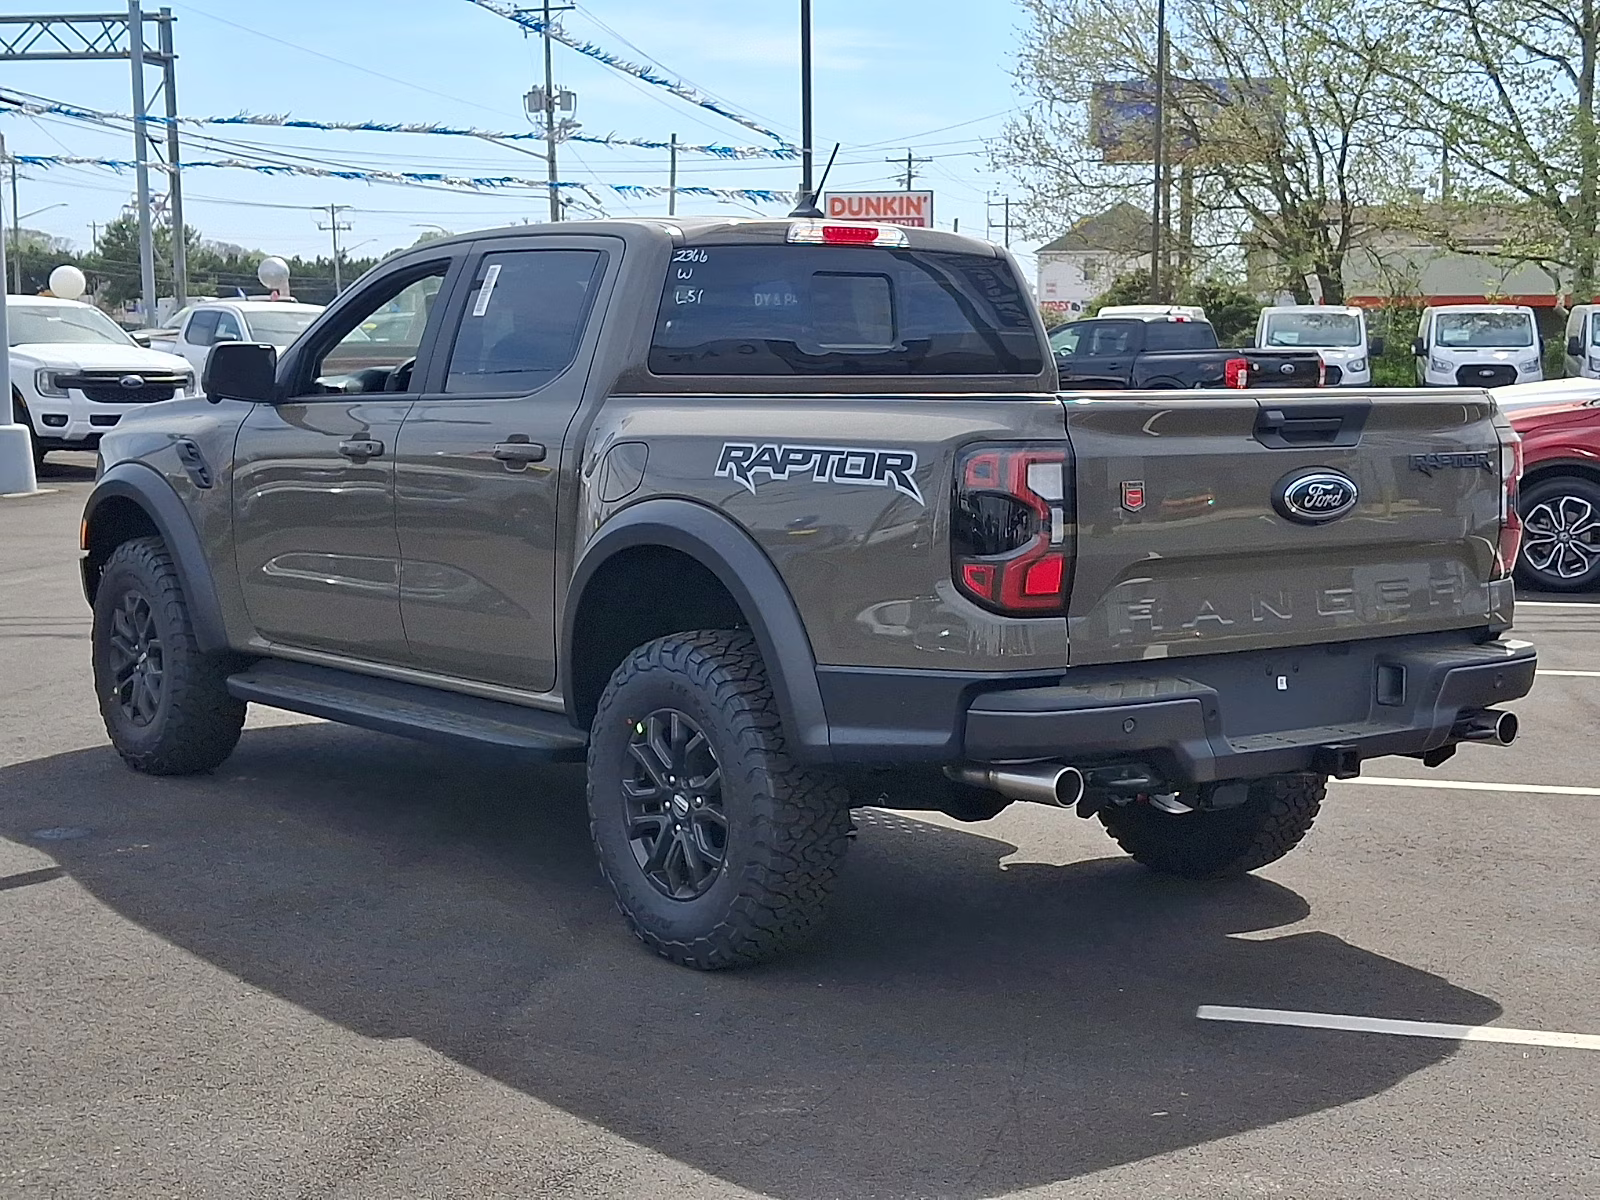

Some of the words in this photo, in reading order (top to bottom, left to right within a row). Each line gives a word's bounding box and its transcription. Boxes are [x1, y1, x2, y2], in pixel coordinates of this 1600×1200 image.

[830, 196, 928, 217] DUNKIN'
[672, 249, 709, 263] 2366
[677, 268, 693, 279] W
[714, 442, 925, 507] RAPTOR
[1408, 451, 1494, 478] RAPTOR
[1304, 483, 1344, 508] Ford
[1119, 575, 1463, 634] RANGER
